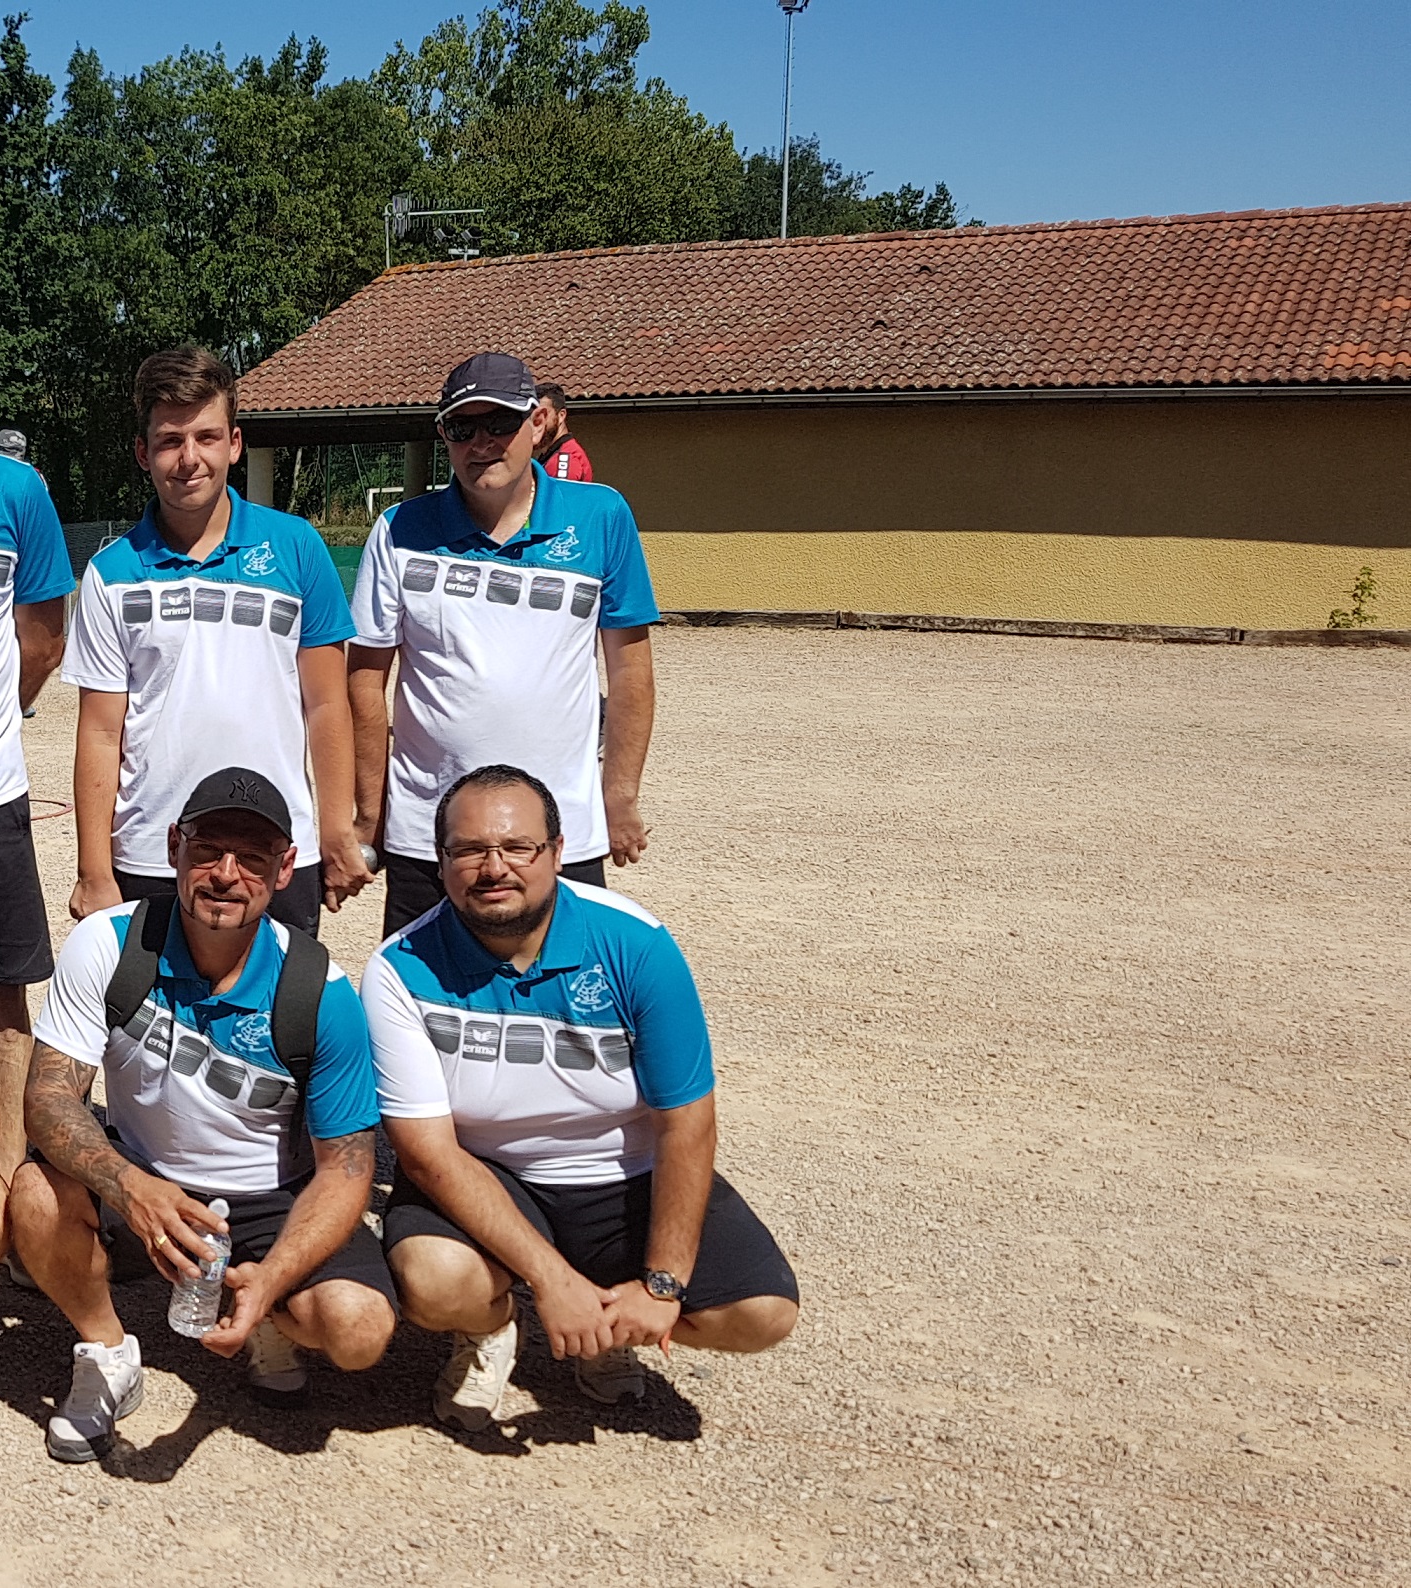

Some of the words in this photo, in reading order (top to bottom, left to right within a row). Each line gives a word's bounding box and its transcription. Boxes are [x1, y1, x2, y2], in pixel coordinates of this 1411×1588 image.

[445, 582, 476, 594] erima
[161, 606, 190, 616] erima
[463, 1043, 497, 1056] erima
